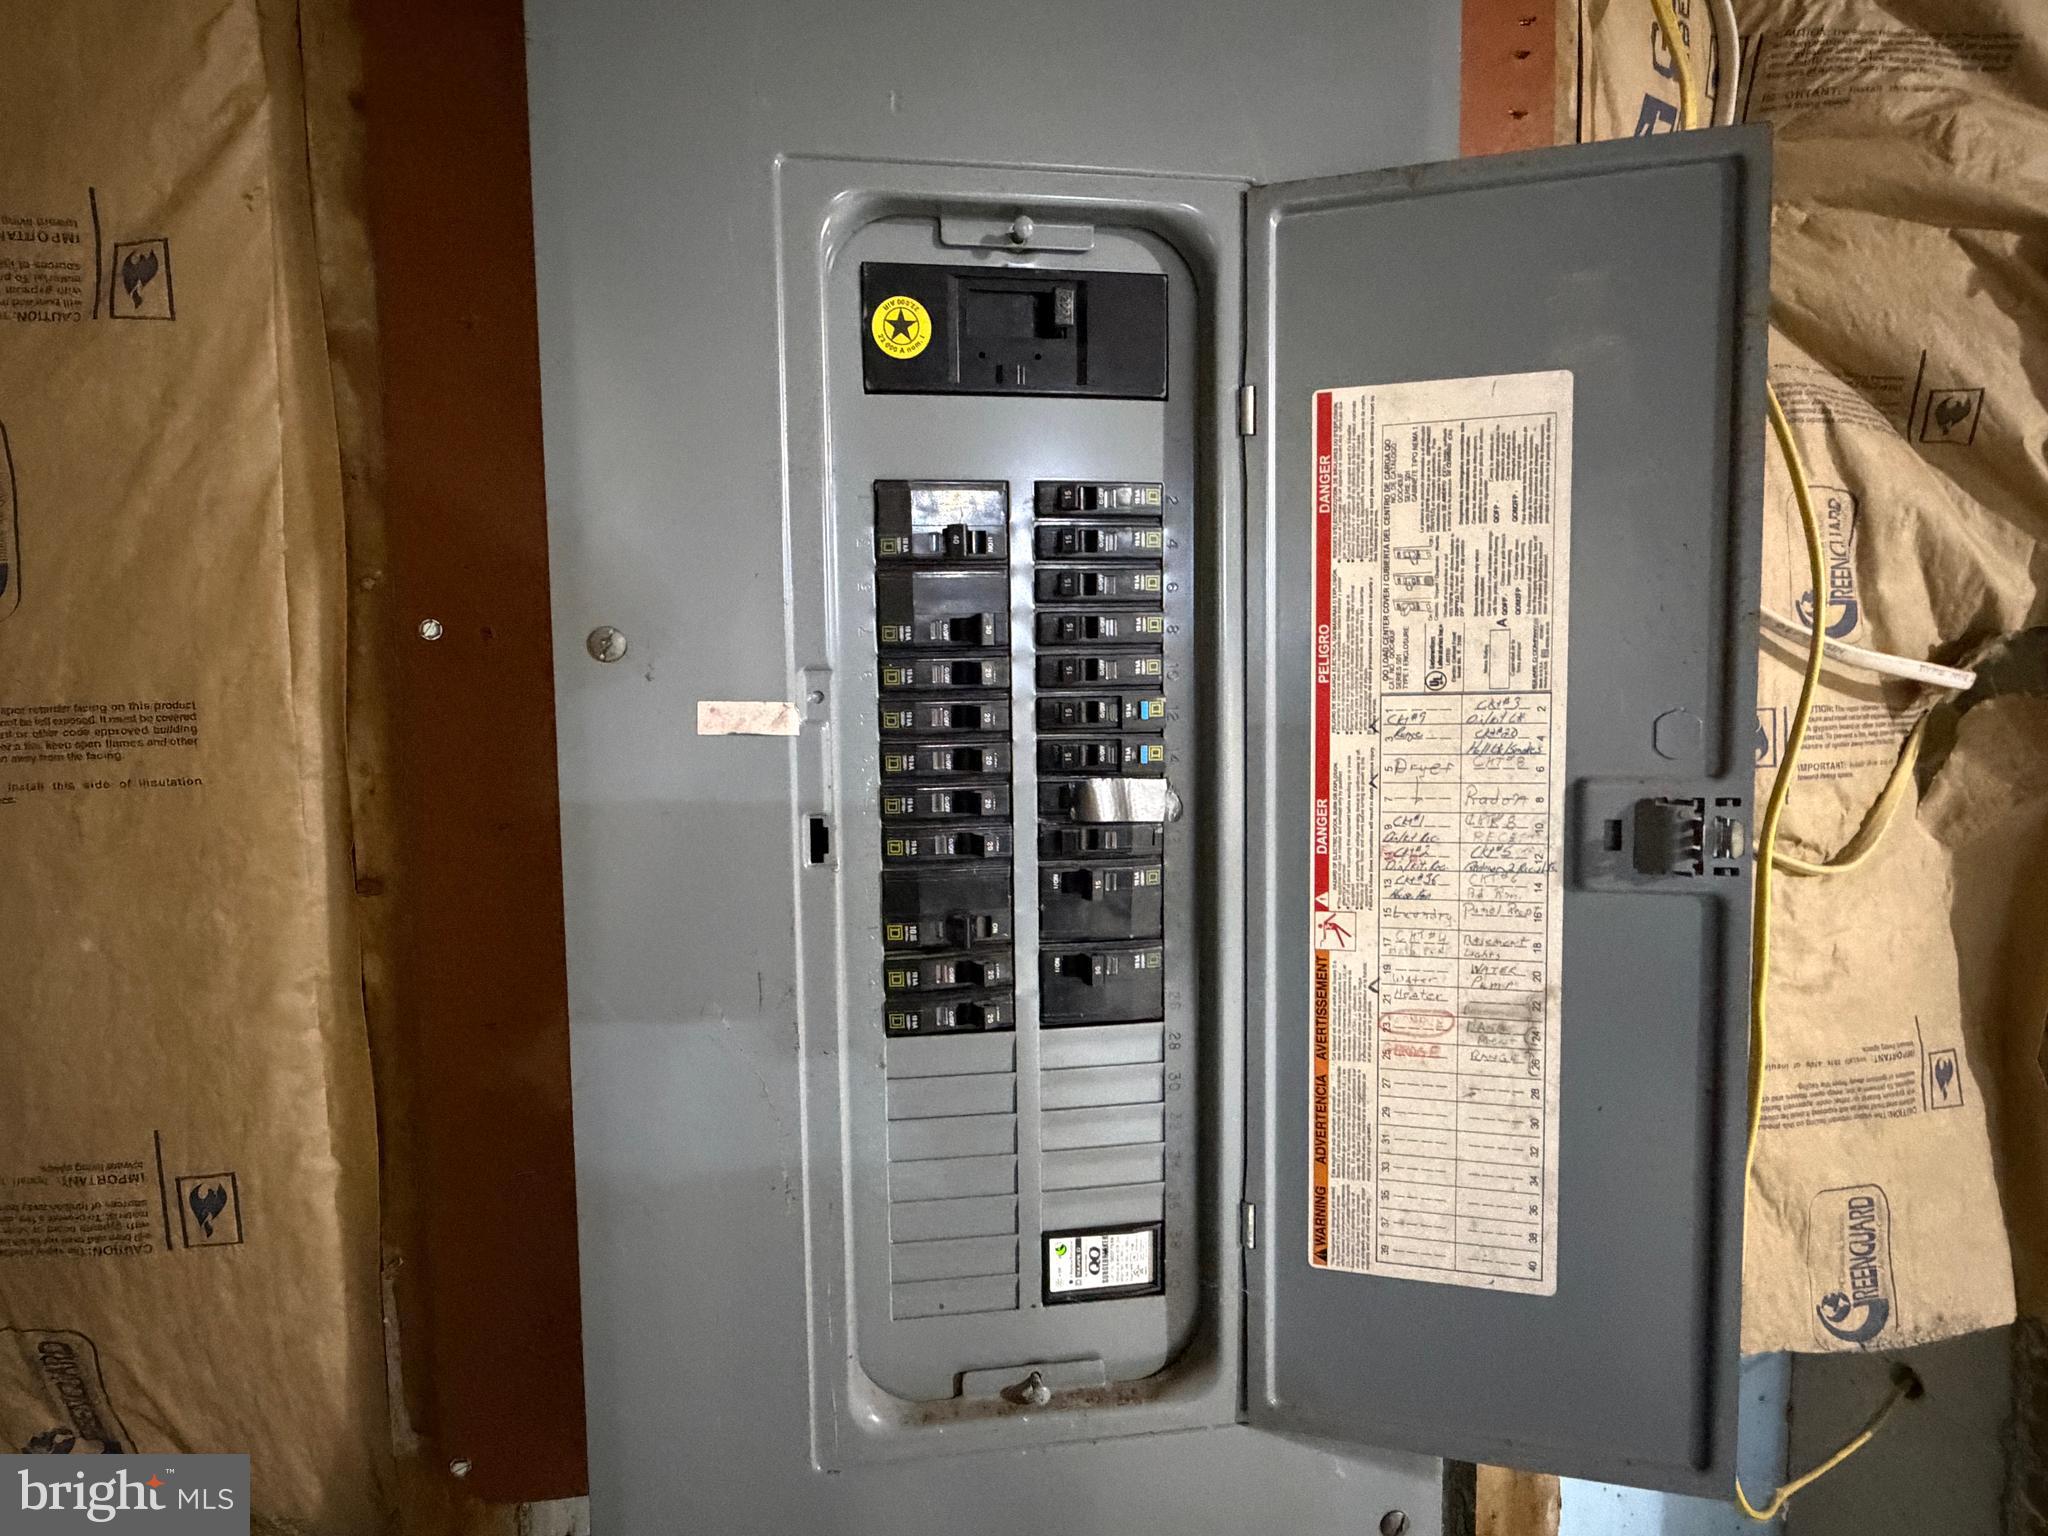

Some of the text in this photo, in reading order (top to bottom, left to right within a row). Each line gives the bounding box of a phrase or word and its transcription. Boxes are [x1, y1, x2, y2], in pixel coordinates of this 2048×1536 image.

[1319, 455, 1331, 514] DANGER
[1384, 483, 1391, 492] DE
[1064, 490, 1072, 499] 15
[1065, 535, 1072, 544] 15
[1064, 578, 1072, 587] 15
[1066, 623, 1074, 632] 15
[1496, 618, 1507, 627] A
[1318, 624, 1329, 683] PELIGRO
[1065, 666, 1073, 675] 15
[1383, 669, 1389, 681] QO
[111, 703, 125, 711] on
[128, 702, 150, 710] this
[154, 701, 196, 712] product
[155, 713, 197, 723] covered
[1065, 708, 1073, 717] 15
[1064, 752, 1072, 762] 15
[119, 778, 131, 787] of
[139, 777, 202, 787] insulation
[1465, 784, 1530, 805] Radon
[1317, 799, 1328, 855] DANGER
[1535, 822, 1544, 833] 10
[1535, 853, 1544, 864] 12
[1384, 878, 1392, 888] 13
[1534, 882, 1543, 892] 14
[1384, 908, 1391, 918] 15
[1534, 911, 1543, 922] 16
[1384, 937, 1391, 947] 17
[1533, 942, 1542, 953] 18
[1383, 964, 1391, 975] 19
[1532, 970, 1542, 982] 20
[1383, 994, 1391, 1005] 21
[1316, 956, 1328, 1060] AVERTISSEMENT
[1532, 1001, 1541, 1012] 22
[1168, 1031, 1182, 1051] 28
[1532, 1031, 1541, 1042] 24
[1531, 1058, 1540, 1071] 26
[1383, 1078, 1390, 1089] 27
[1530, 1088, 1539, 1099] 28
[1382, 1106, 1390, 1117] 29
[1316, 1074, 1327, 1165] ADVERTENCIA
[1530, 1118, 1539, 1130] 30
[1382, 1134, 1389, 1144] 31
[1530, 1146, 1538, 1158] 32
[1382, 1161, 1389, 1172] 33
[1530, 1175, 1538, 1186] 34
[1382, 1190, 1389, 1201] 35
[1315, 1186, 1326, 1246] WARNING
[1529, 1205, 1538, 1216] 36
[1382, 1217, 1389, 1228] 37
[1529, 1232, 1537, 1244] 38
[1381, 1245, 1389, 1255] 39
[1089, 1246, 1101, 1275] QO
[1529, 1261, 1537, 1272] 40
[1816, 1196, 1890, 1343] GREENGUARD
